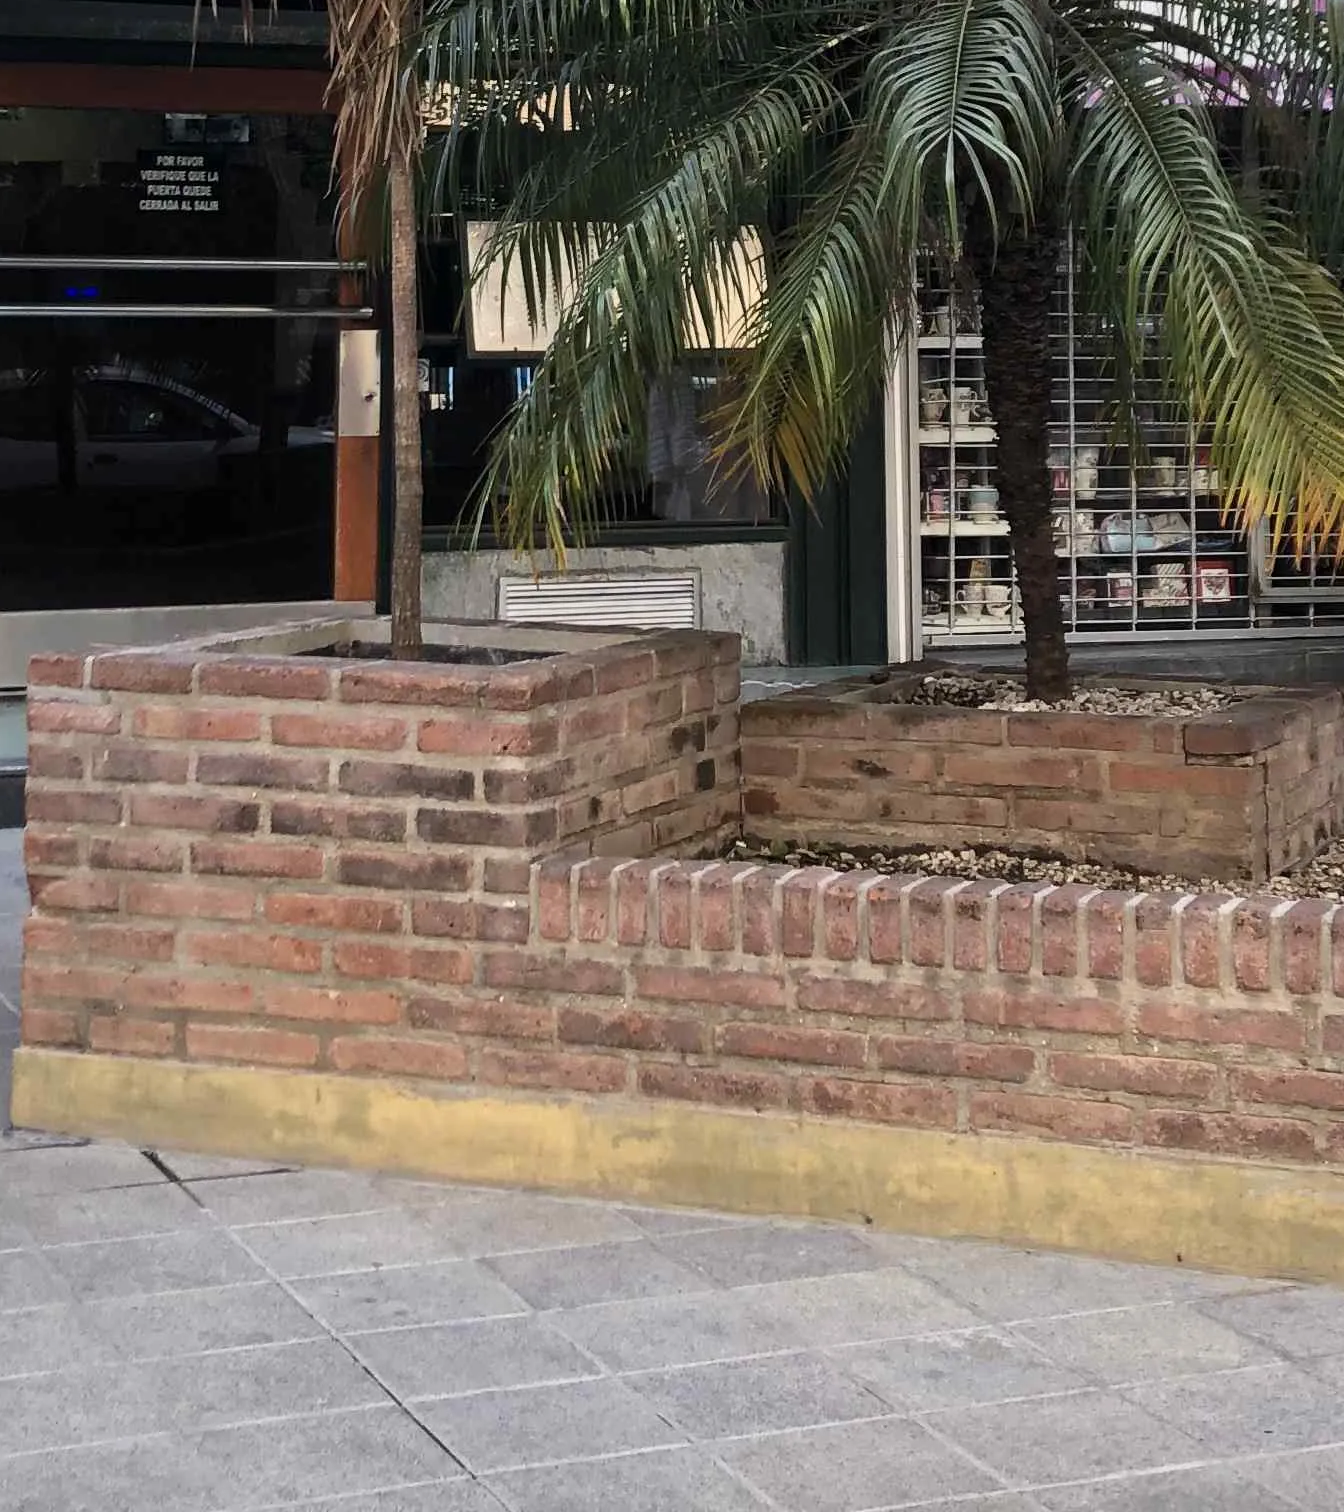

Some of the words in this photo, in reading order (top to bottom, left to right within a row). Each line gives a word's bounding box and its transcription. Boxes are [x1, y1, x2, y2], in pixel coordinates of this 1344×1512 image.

[156, 155, 175, 167] POR
[177, 156, 204, 167] FAVOR
[188, 170, 207, 182] QUE
[207, 171, 219, 182] LA
[147, 184, 181, 196] PUERTA
[180, 199, 193, 211] AL
